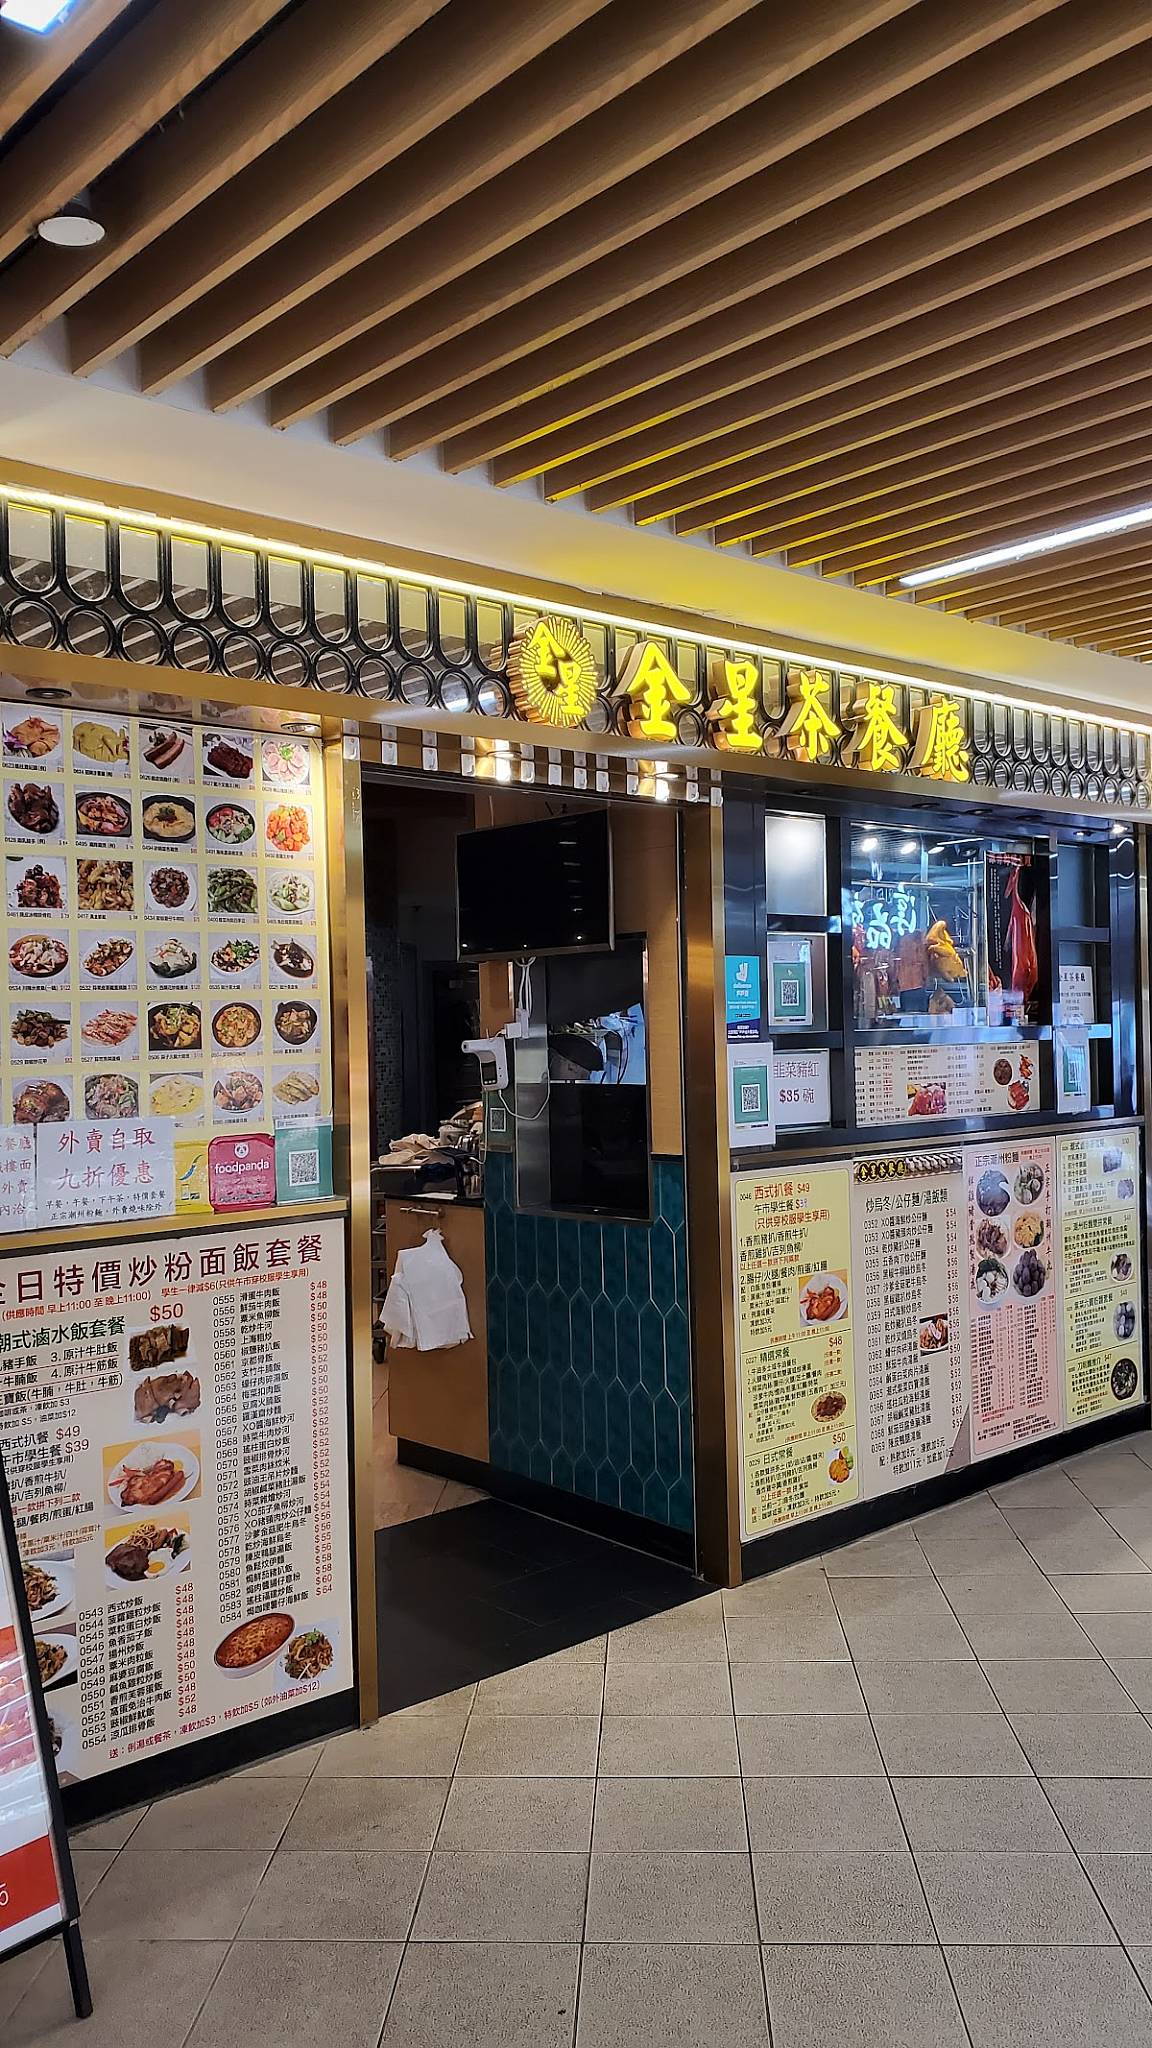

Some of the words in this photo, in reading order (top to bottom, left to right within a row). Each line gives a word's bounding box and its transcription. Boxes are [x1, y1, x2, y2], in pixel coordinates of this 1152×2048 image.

[628, 641, 969, 782] 金星茶餐廳
[779, 1089, 800, 1103] $35
[0, 1136, 32, 1151] 餐廳
[58, 1127, 156, 1154] 外賣自取
[0, 1159, 31, 1174] 樓面
[214, 1158, 270, 1175] foodpanda
[57, 1160, 155, 1191] 九折優惠
[754, 1182, 793, 1200] 西式扒餐
[754, 1199, 794, 1215] 午市學生餐
[0, 1234, 322, 1303] 日特價炒粉面飯套餐
[93, 1297, 104, 1307] 至
[212, 1295, 235, 1306] 0555
[150, 1303, 184, 1322] $50
[213, 1305, 235, 1316] 0556
[213, 1316, 235, 1328] 0557
[213, 1328, 236, 1338] 0558
[829, 1336, 842, 1347] $48
[214, 1338, 236, 1349] 0559
[0, 1354, 38, 1371] 豬手飯
[0, 1372, 38, 1387] 牛腩飯
[215, 1371, 236, 1382] 0562
[0, 1430, 49, 1452] 西式扒餐
[56, 1425, 80, 1440] $49
[216, 1426, 237, 1438] 0567
[832, 1432, 846, 1444] $50
[65, 1439, 89, 1454] $39
[216, 1437, 238, 1448] 0568
[216, 1448, 238, 1459] 0569
[7, 1468, 67, 1490] 扒/香煎牛扒/
[217, 1481, 238, 1493] 0572
[12, 1501, 94, 1528] 腿/餐肉/煎蛋/紅腸
[79, 1607, 104, 1621] 0543
[108, 1596, 143, 1614] 西式炒飯
[175, 1582, 194, 1595] $48
[220, 1600, 241, 1613] 0583
[79, 1619, 104, 1632] 0544
[176, 1594, 194, 1606] $48
[220, 1610, 241, 1624] 0584
[80, 1630, 104, 1644] 0545
[176, 1605, 194, 1617] $48
[80, 1642, 104, 1656] 0546
[176, 1616, 194, 1628] $48
[80, 1653, 104, 1668] 0547
[176, 1627, 194, 1639] $48
[80, 1665, 105, 1679] 0548
[176, 1638, 195, 1651] $48
[80, 1676, 105, 1691] 0549
[176, 1649, 195, 1662] $48
[80, 1688, 106, 1702] 0550
[177, 1660, 195, 1673] $50
[81, 1700, 104, 1714] 0551
[177, 1671, 196, 1684] $50
[81, 1711, 106, 1726] 0552
[178, 1682, 196, 1695] $48
[82, 1722, 106, 1738] 0553
[178, 1693, 196, 1706] $52
[82, 1734, 107, 1750] 0554
[178, 1705, 197, 1718] $48
